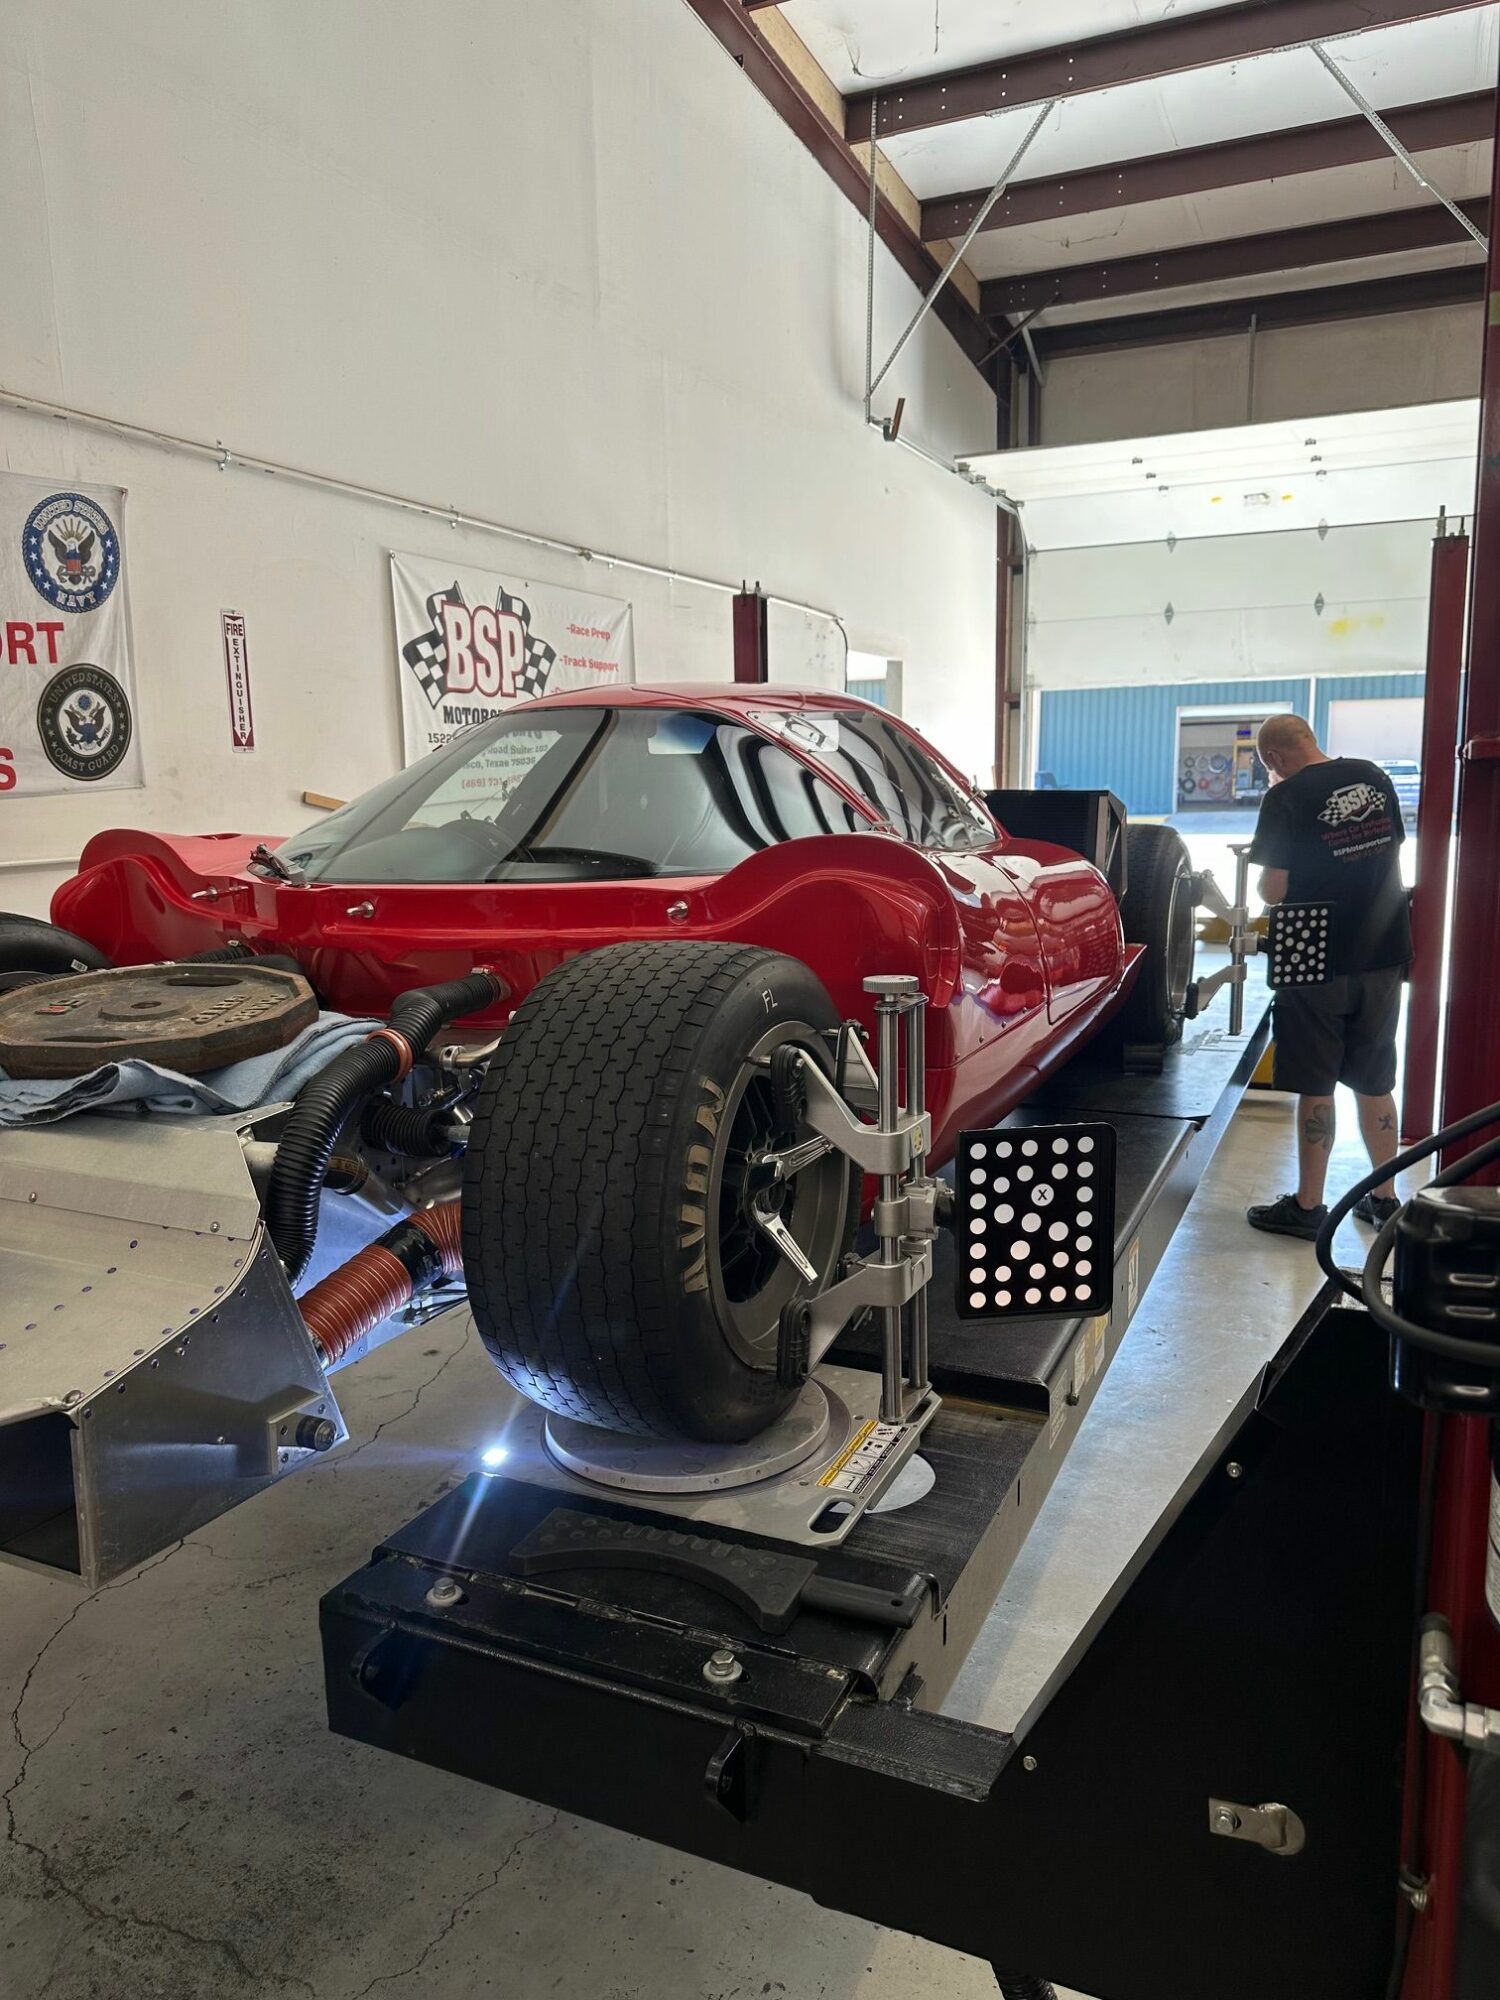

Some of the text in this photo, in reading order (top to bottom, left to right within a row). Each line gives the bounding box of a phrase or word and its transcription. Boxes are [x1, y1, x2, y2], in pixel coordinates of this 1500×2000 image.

[33, 499, 109, 535] UNITED STATES
[57, 590, 96, 607] NAVY
[0, 621, 64, 664] RT
[225, 623, 243, 636] FIRE
[591, 627, 611, 642] Prep
[441, 600, 525, 698] BSP
[588, 658, 619, 672] Support
[49, 672, 119, 703] UNITED STATES
[232, 638, 247, 739] EXTINGUISHER
[55, 744, 119, 771] COAST GUARD
[1337, 786, 1370, 818] BSP
[762, 988, 778, 1014] FL
[680, 1077, 725, 1293] AVON
[1037, 1189, 1048, 1201] X
